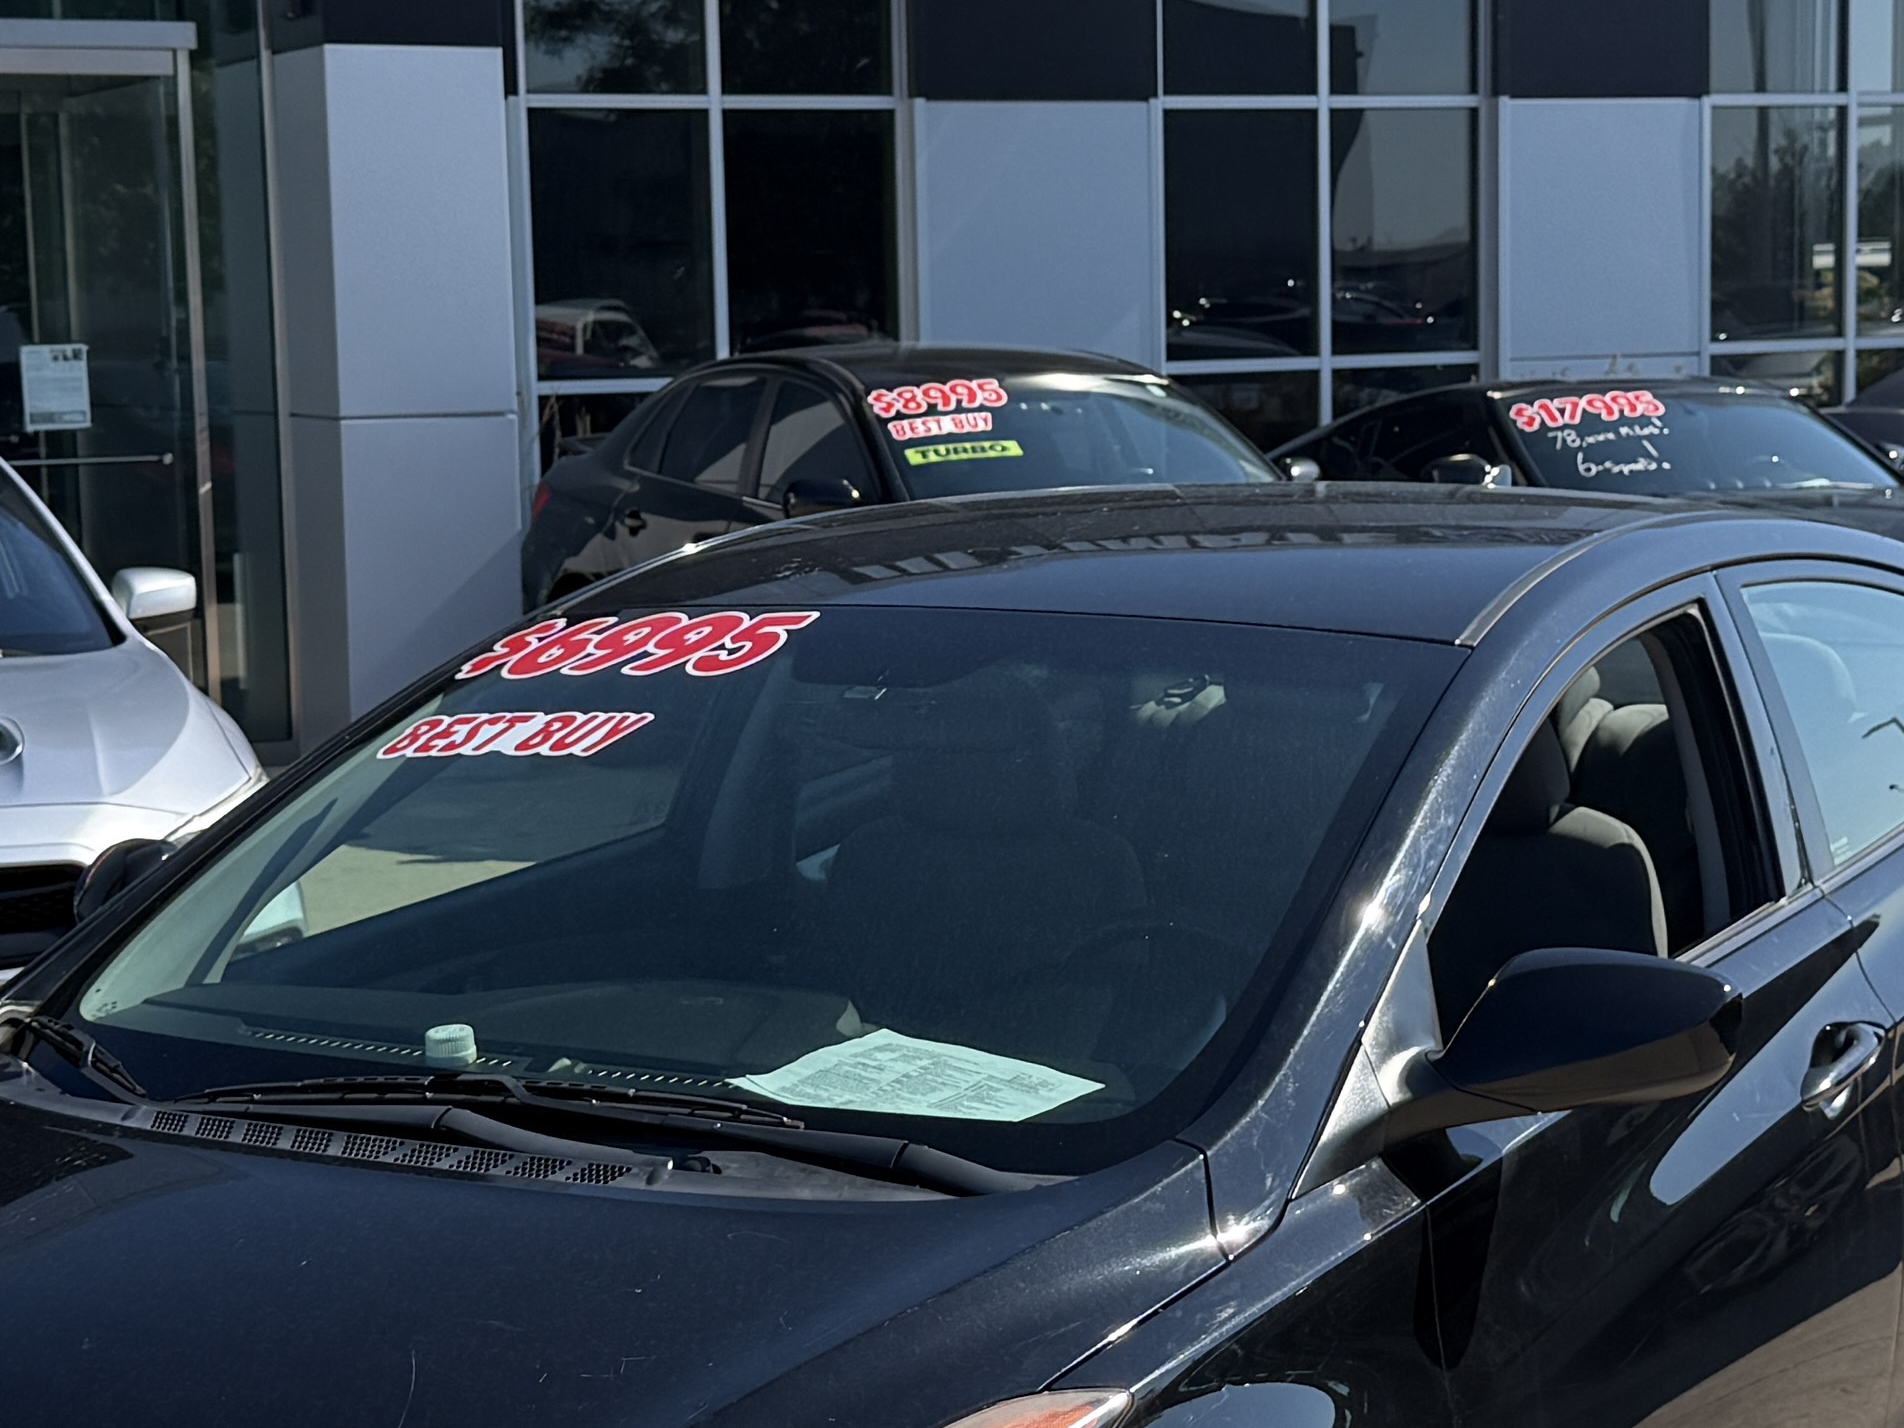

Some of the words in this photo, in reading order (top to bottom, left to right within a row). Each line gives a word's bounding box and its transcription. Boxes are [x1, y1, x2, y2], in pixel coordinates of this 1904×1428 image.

[867, 378, 1008, 418] $8995
[1509, 390, 1666, 433] $17995
[889, 417, 944, 440] BEST
[950, 412, 993, 433] BUY
[914, 442, 1011, 460] TURBO
[455, 610, 821, 679] $6995
[377, 713, 537, 759] BEST
[512, 711, 655, 756] BUY
